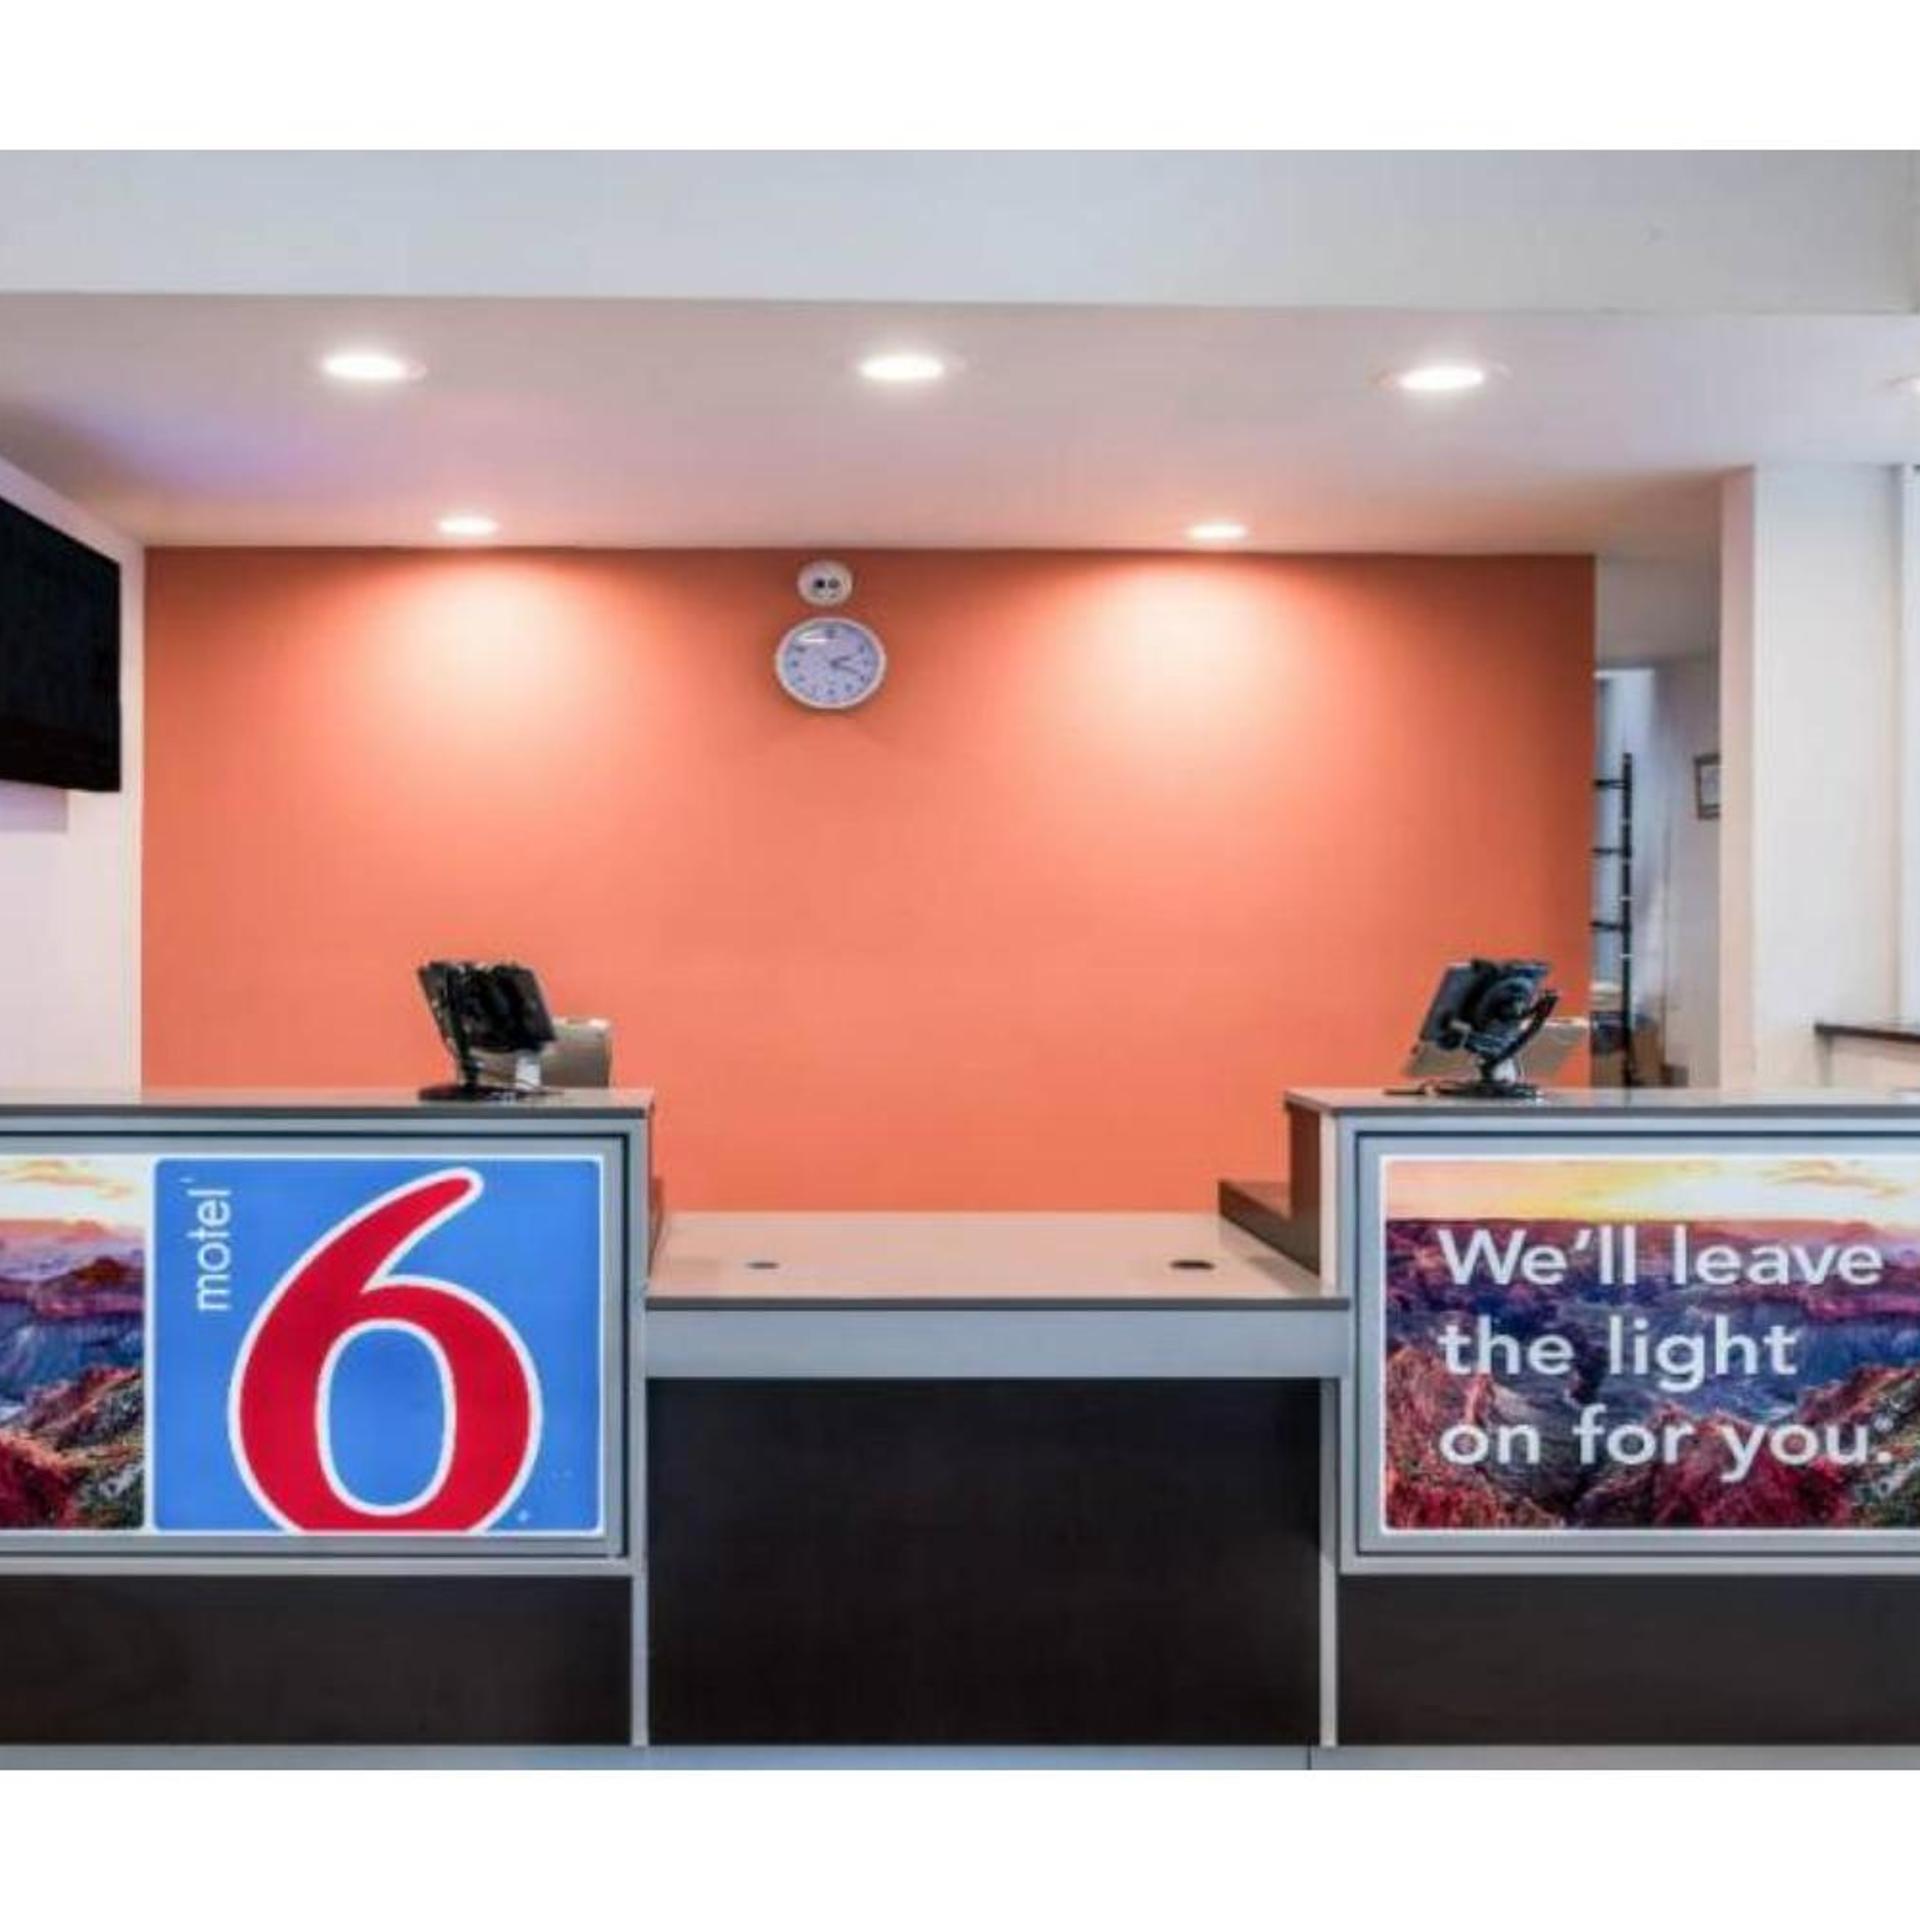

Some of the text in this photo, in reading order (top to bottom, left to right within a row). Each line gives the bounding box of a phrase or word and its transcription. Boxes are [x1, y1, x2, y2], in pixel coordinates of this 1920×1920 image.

[1438, 1225, 1884, 1286] We’ll leave
[186, 1167, 543, 1533] motel 6
[1438, 1315, 1800, 1393] the light
[1438, 1423, 1541, 1465] on
[1572, 1404, 1695, 1466] for
